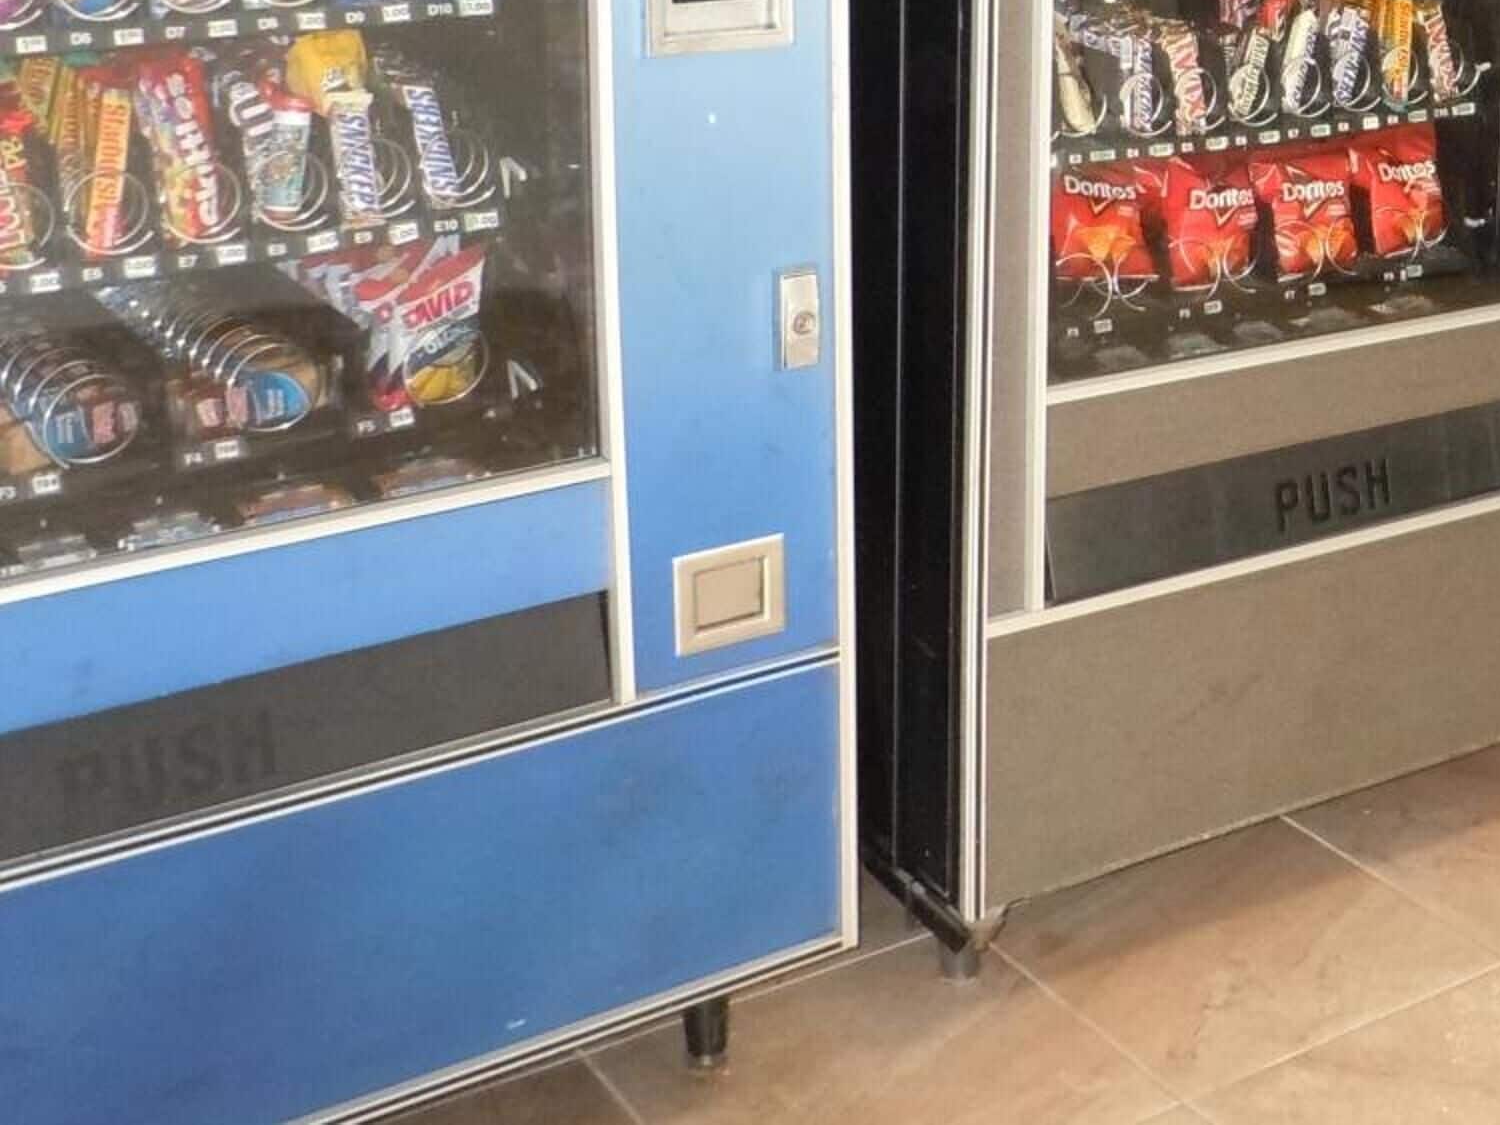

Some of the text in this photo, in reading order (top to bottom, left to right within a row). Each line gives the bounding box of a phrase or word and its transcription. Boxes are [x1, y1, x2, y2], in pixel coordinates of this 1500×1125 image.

[1377, 159, 1436, 183] Doritos
[1063, 174, 1137, 201] Doritos
[1281, 179, 1345, 203] Doritos
[1274, 457, 1391, 532] PUSH
[57, 708, 277, 811] PUSH
